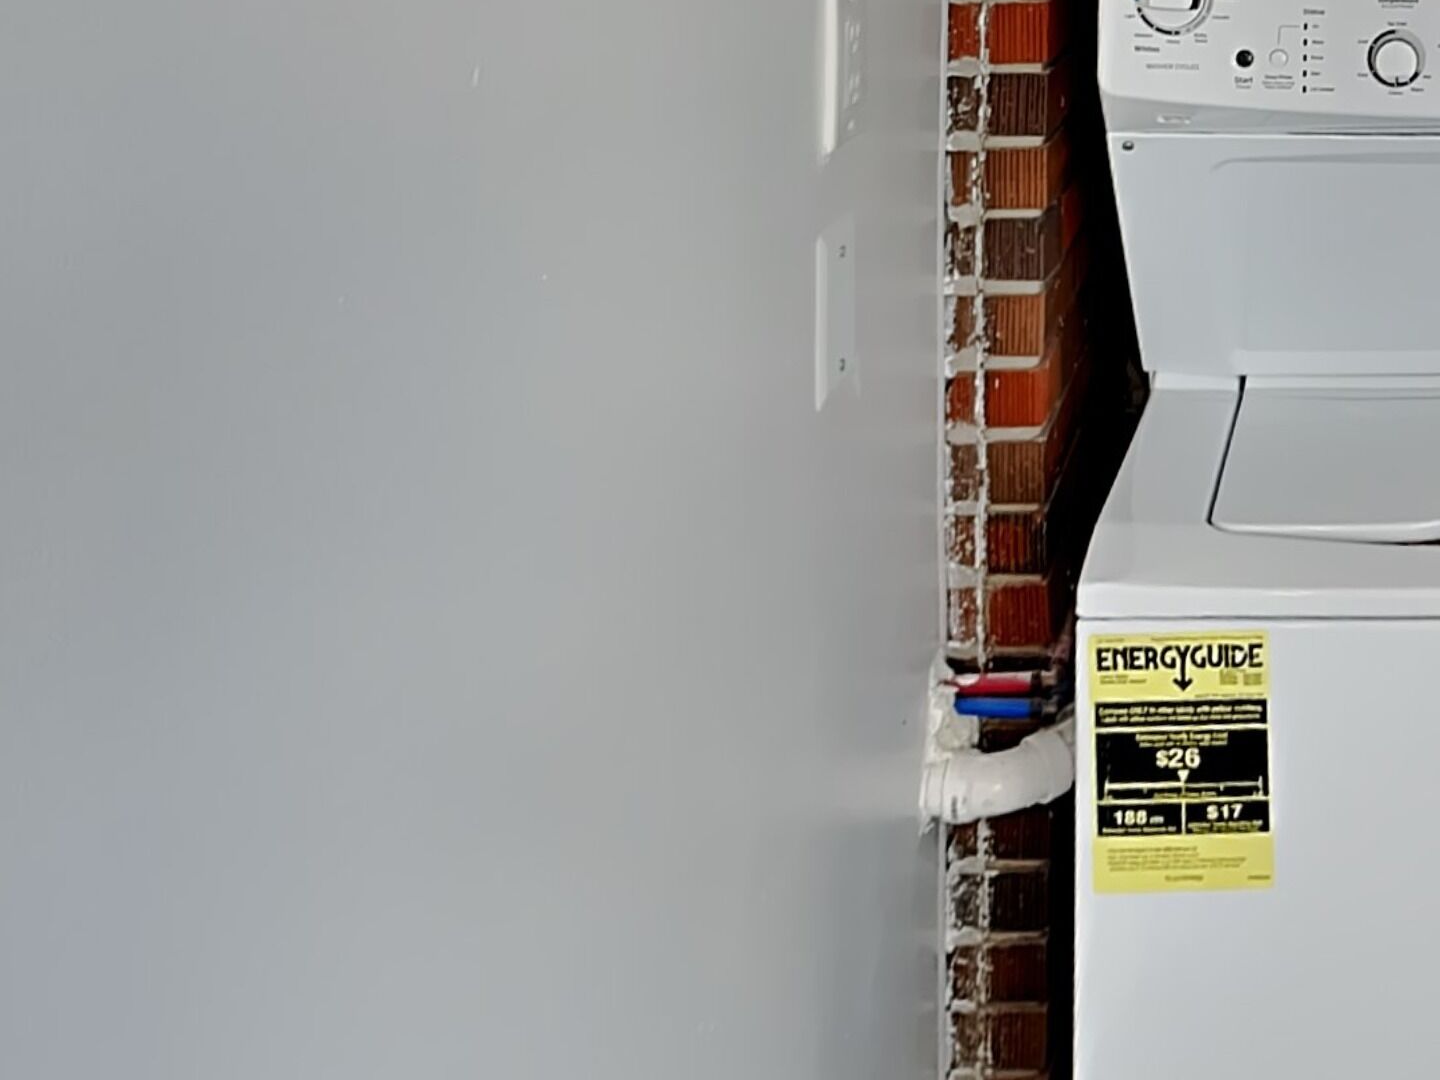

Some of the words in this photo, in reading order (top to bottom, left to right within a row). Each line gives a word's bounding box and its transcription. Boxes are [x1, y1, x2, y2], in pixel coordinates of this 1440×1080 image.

[1233, 75, 1254, 84] Start
[1096, 643, 1263, 672] ENERGYGUIDE
[1155, 747, 1201, 769] $26
